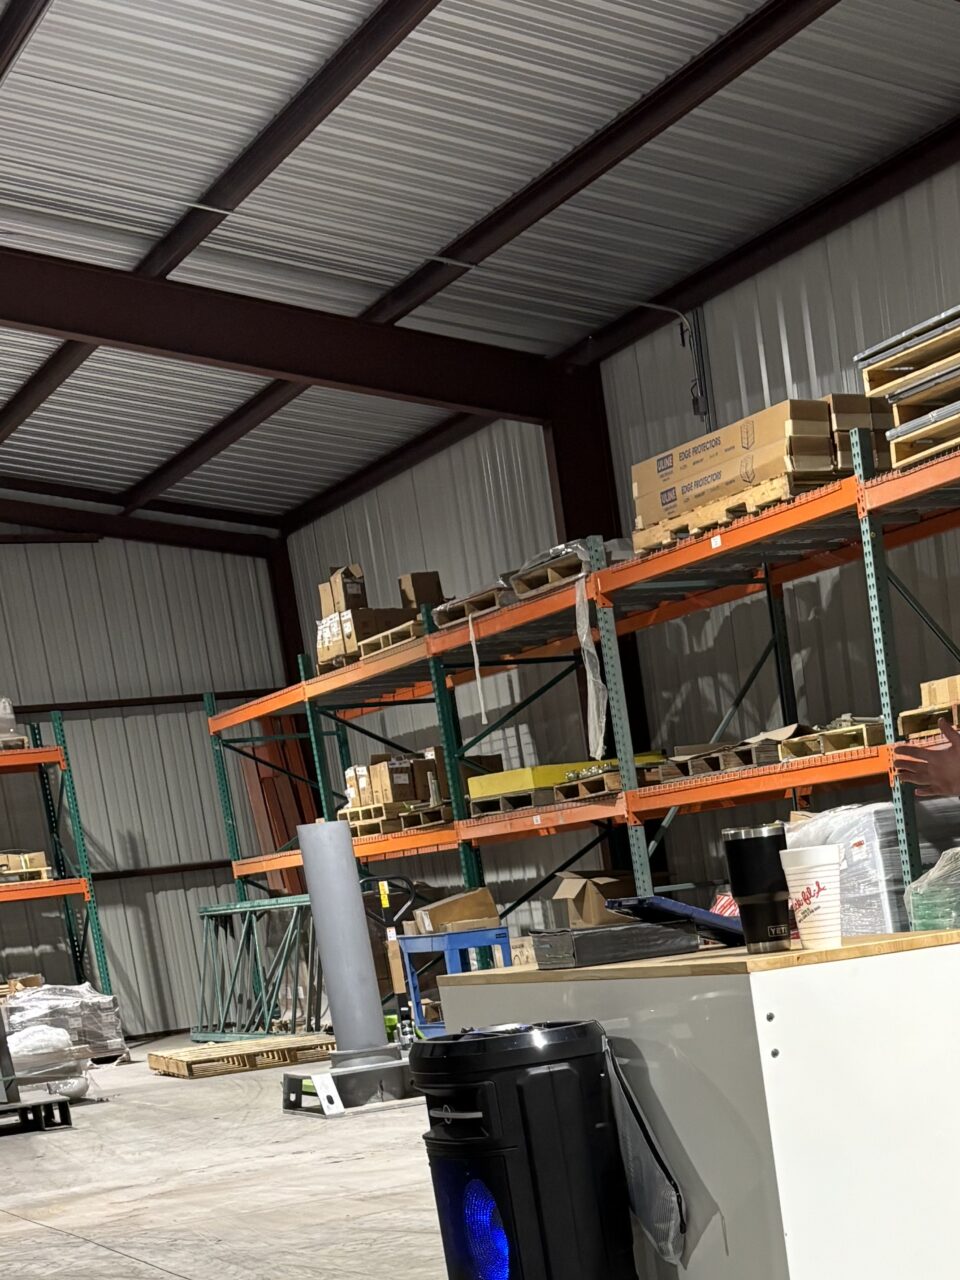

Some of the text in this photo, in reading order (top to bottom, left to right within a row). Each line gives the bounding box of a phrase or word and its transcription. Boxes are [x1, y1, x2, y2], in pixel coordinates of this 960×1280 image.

[679, 448, 691, 461] EDGE
[691, 436, 721, 455] PROTECTORS
[657, 454, 673, 473] ULINE
[681, 482, 693, 495] EDGE
[694, 471, 721, 489] PROTECTORS
